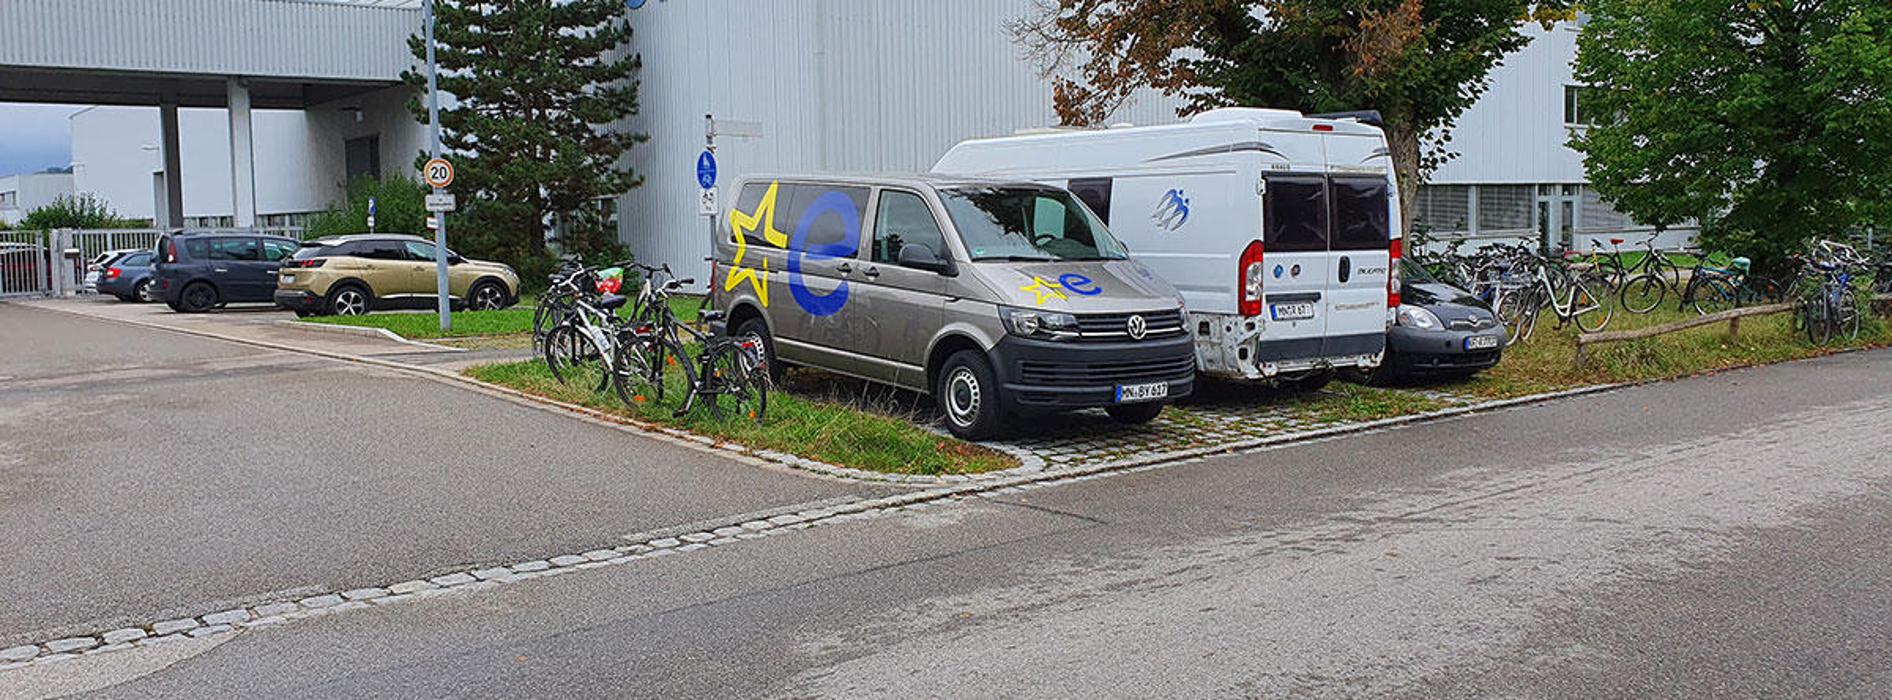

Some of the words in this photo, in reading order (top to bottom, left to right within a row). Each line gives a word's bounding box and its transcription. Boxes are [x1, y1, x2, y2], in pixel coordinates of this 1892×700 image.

[430, 166, 447, 179] 20
[1122, 386, 1134, 399] MN
[1151, 382, 1167, 397] 617
